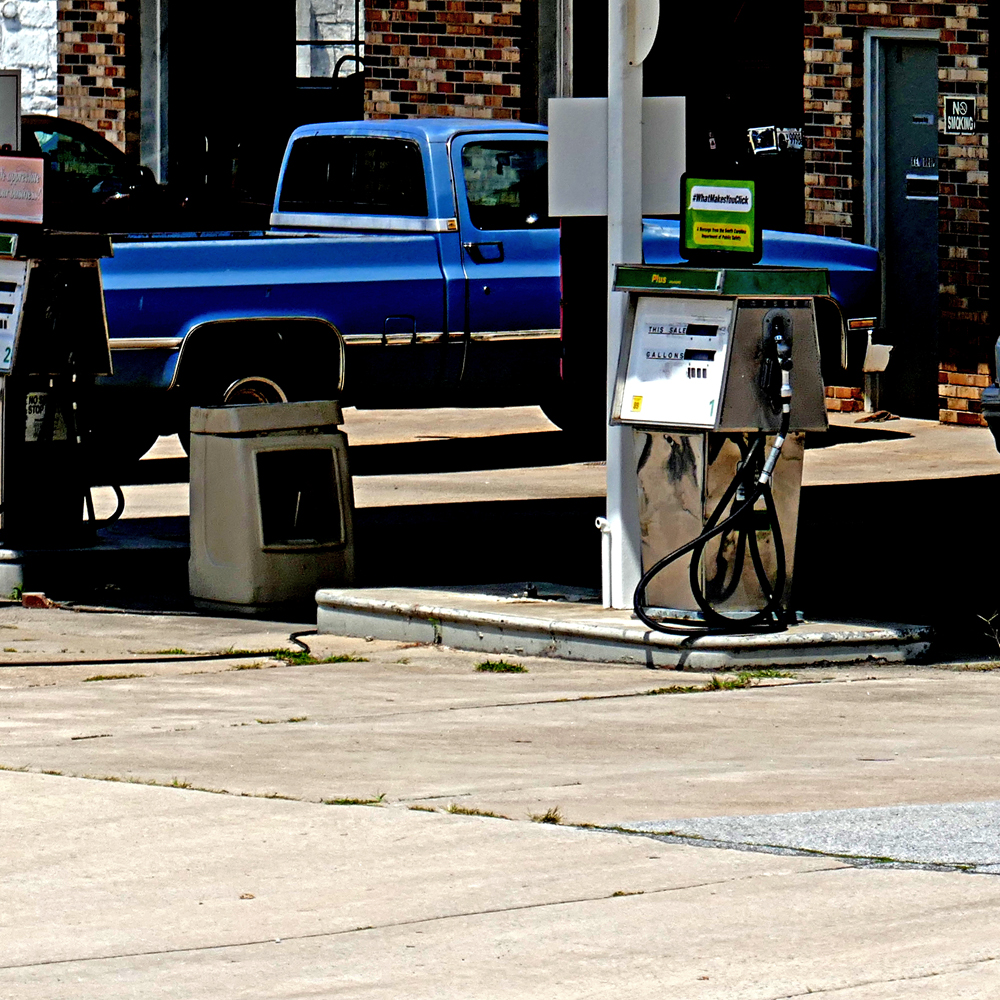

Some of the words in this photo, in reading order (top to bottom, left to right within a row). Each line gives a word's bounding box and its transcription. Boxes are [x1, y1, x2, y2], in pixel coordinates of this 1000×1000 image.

[952, 101, 968, 115] NO
[947, 115, 974, 131] SMOKING
[692, 193, 749, 205] #WhatMakesYouClick
[651, 273, 667, 284] Plus
[669, 326, 687, 334] SALE
[3, 346, 12, 363] 2
[645, 351, 684, 360] GALLONS
[708, 399, 715, 417] 1
